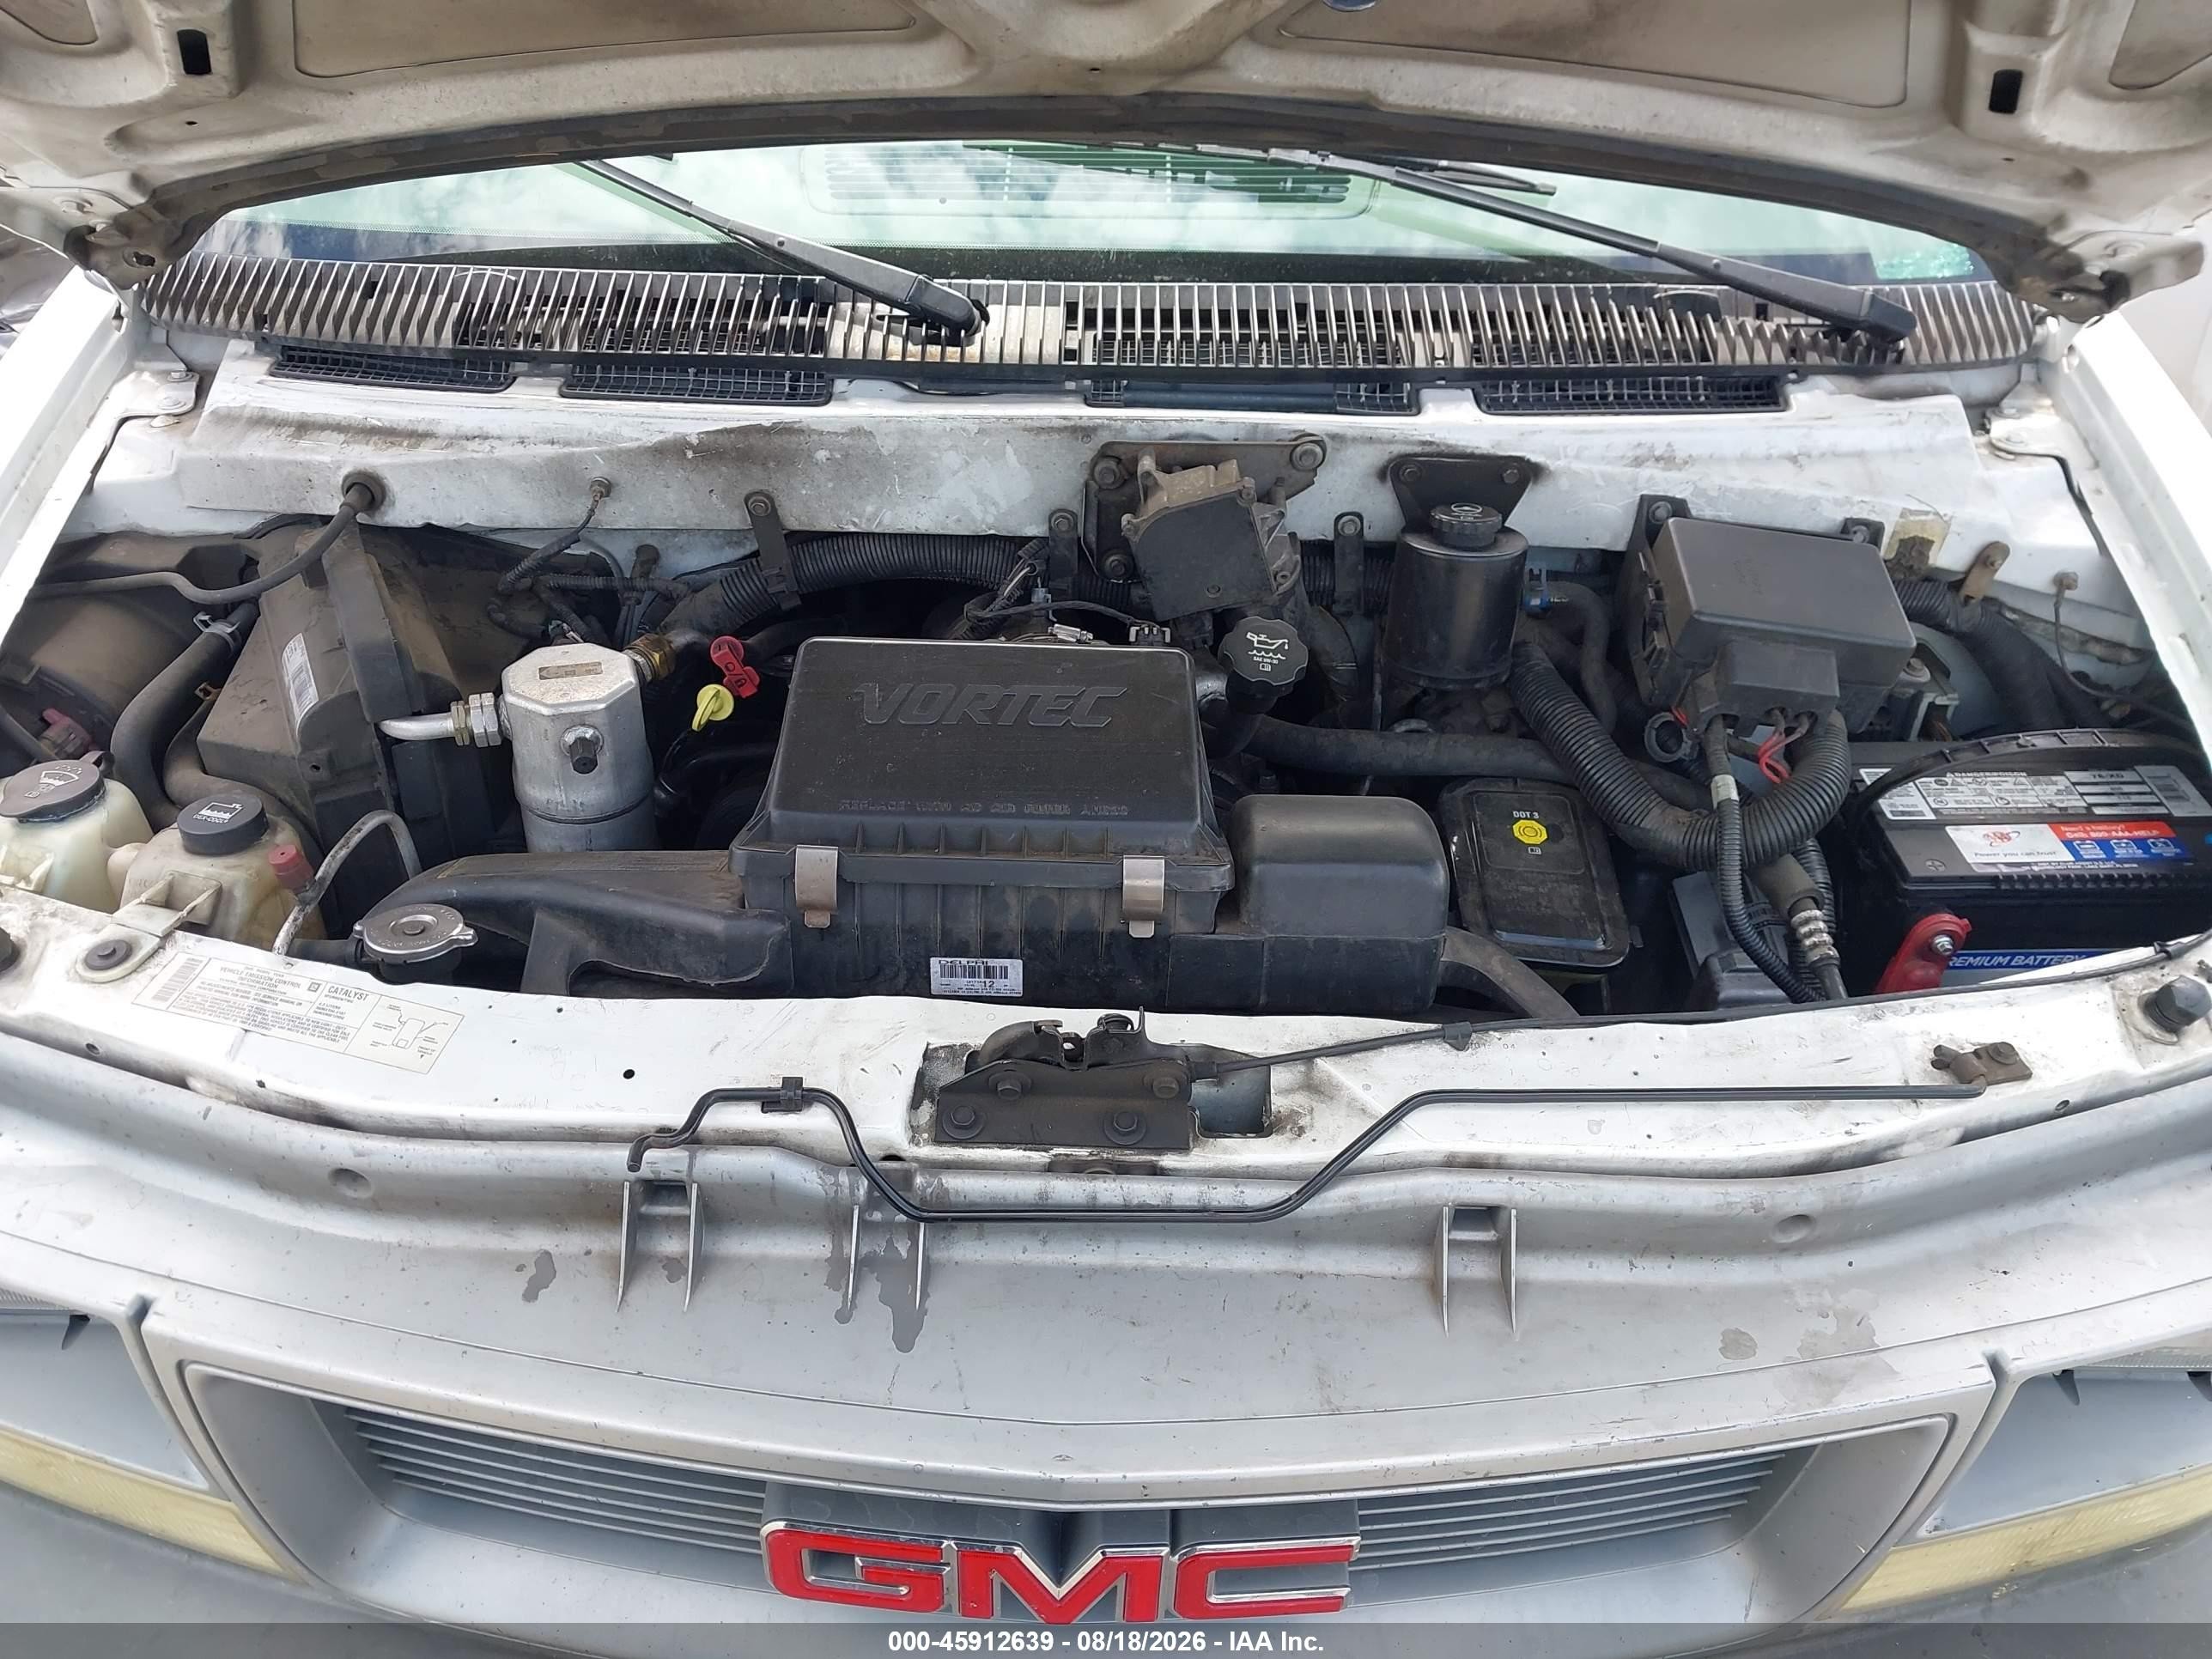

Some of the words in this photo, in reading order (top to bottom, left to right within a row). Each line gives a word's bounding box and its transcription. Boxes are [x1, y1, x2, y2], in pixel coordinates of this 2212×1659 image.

[854, 684, 1127, 727] VORTEC
[1949, 956, 2009, 966] REMIUM
[328, 986, 367, 1000] CATALYST
[760, 1518, 1361, 1625] GMC
